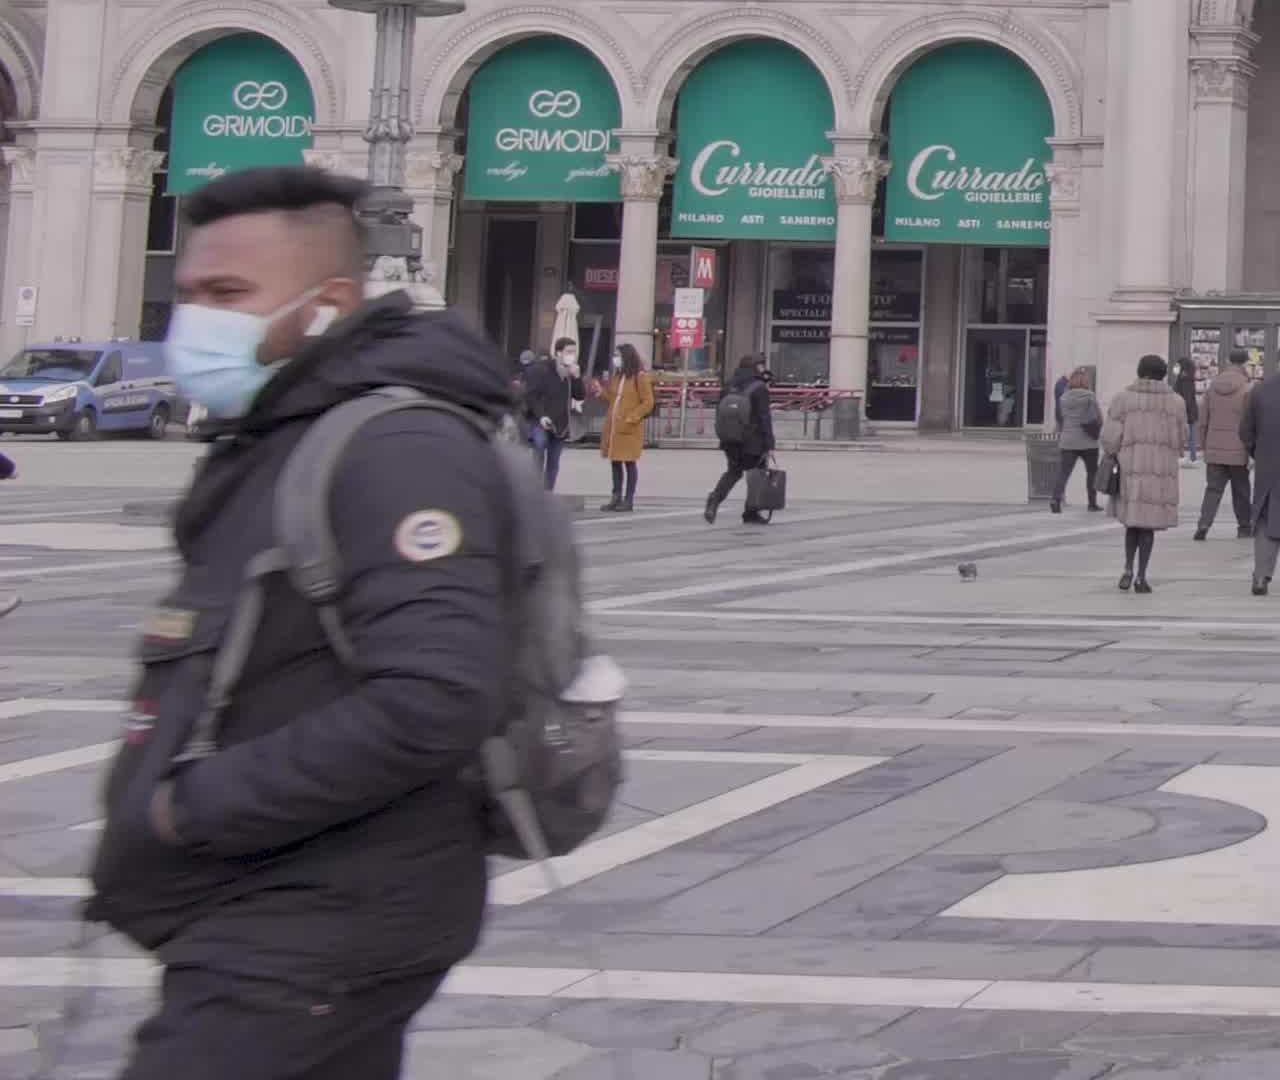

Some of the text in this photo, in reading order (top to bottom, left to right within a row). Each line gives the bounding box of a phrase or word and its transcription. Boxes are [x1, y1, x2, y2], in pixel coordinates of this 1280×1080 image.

[496, 128, 610, 152] GRIMOLDI
[690, 140, 828, 196] Currado
[907, 145, 1046, 201] Currado
[749, 186, 826, 200] GIOIELLERIE
[965, 191, 1043, 204] GIOIELLERIE
[678, 212, 835, 226] MILANO ASTI SANREMO
[895, 216, 1051, 230] MILANO ASTI SANREMO
[697, 257, 713, 279] M
